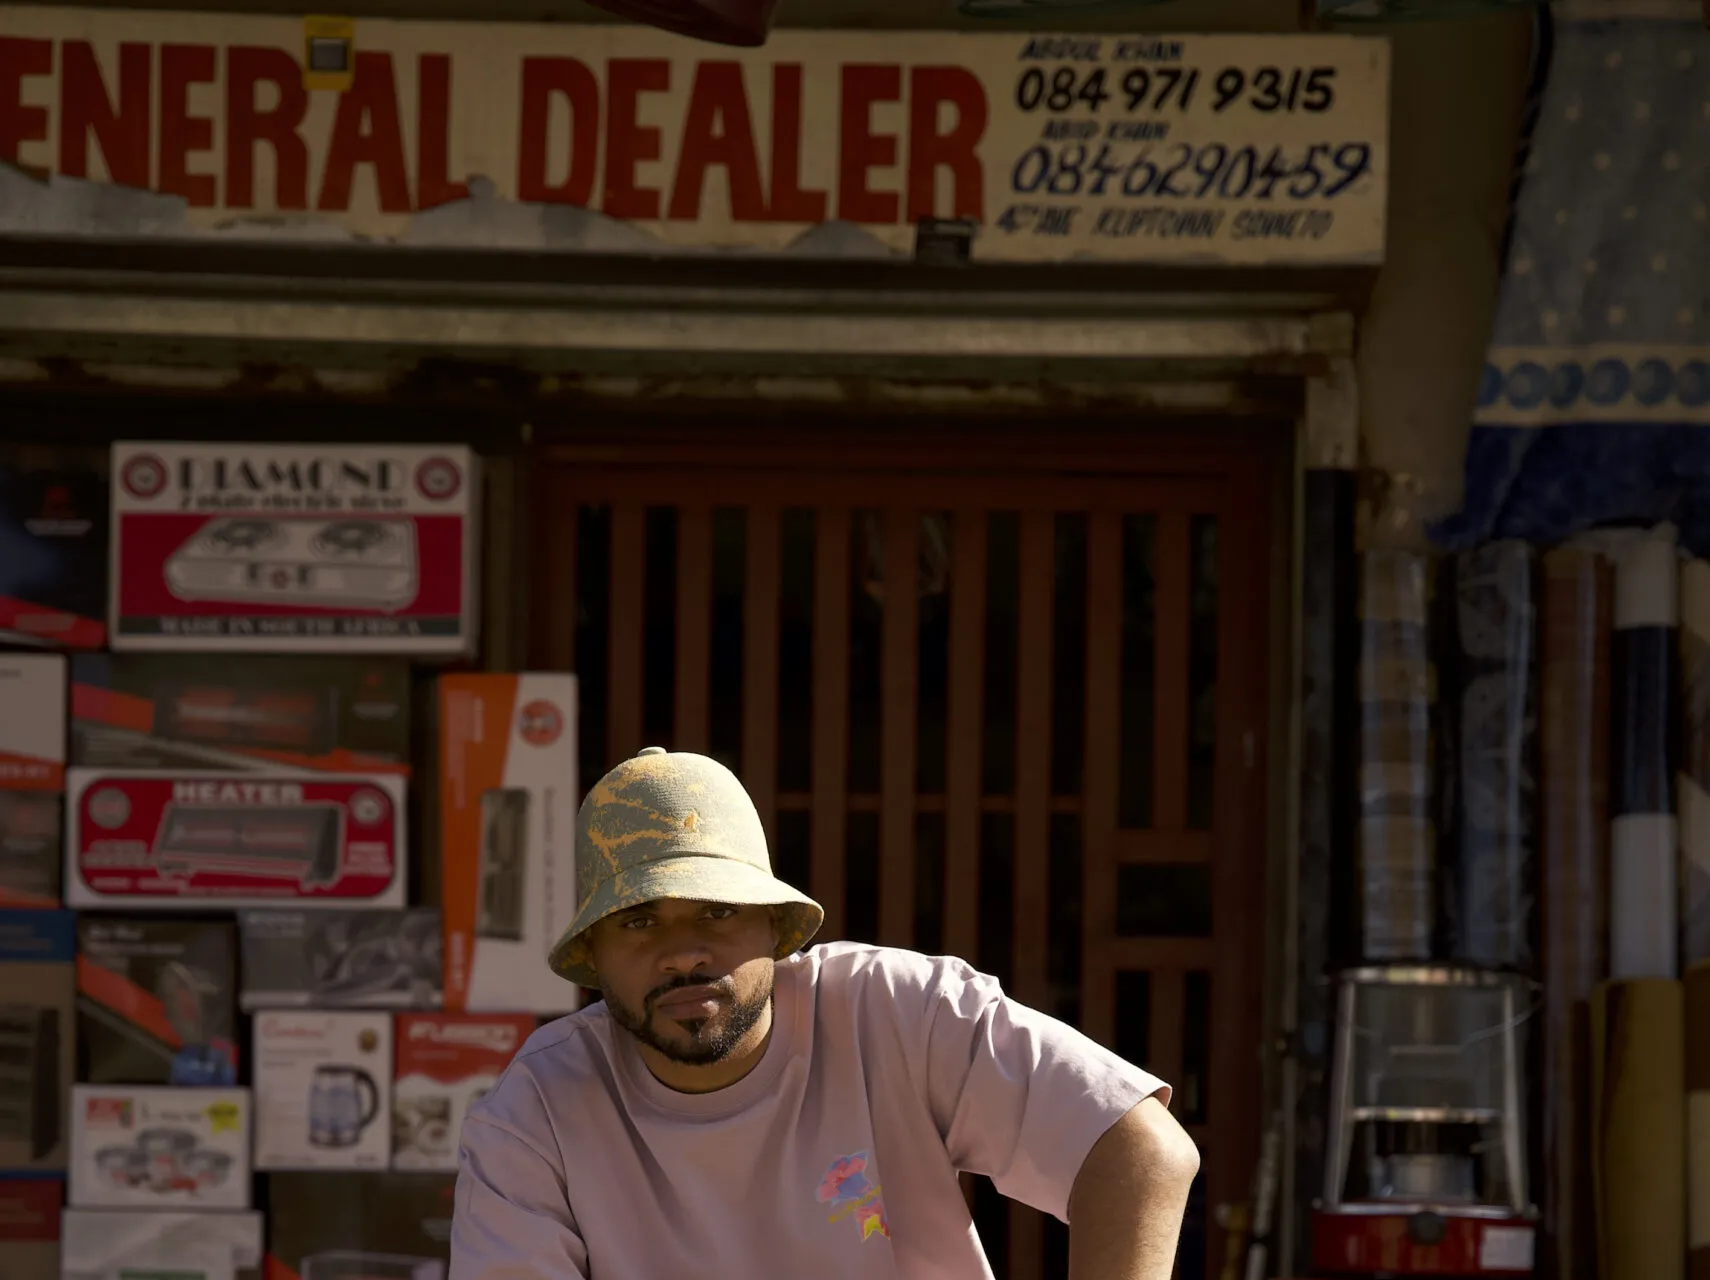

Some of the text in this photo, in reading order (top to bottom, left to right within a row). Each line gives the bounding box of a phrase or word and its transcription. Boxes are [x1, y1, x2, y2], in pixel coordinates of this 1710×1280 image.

[1018, 67, 1336, 113] 084 971 9315
[517, 56, 987, 224] DEALER
[179, 457, 405, 493] DIAMOND
[172, 780, 302, 804] HEATER
